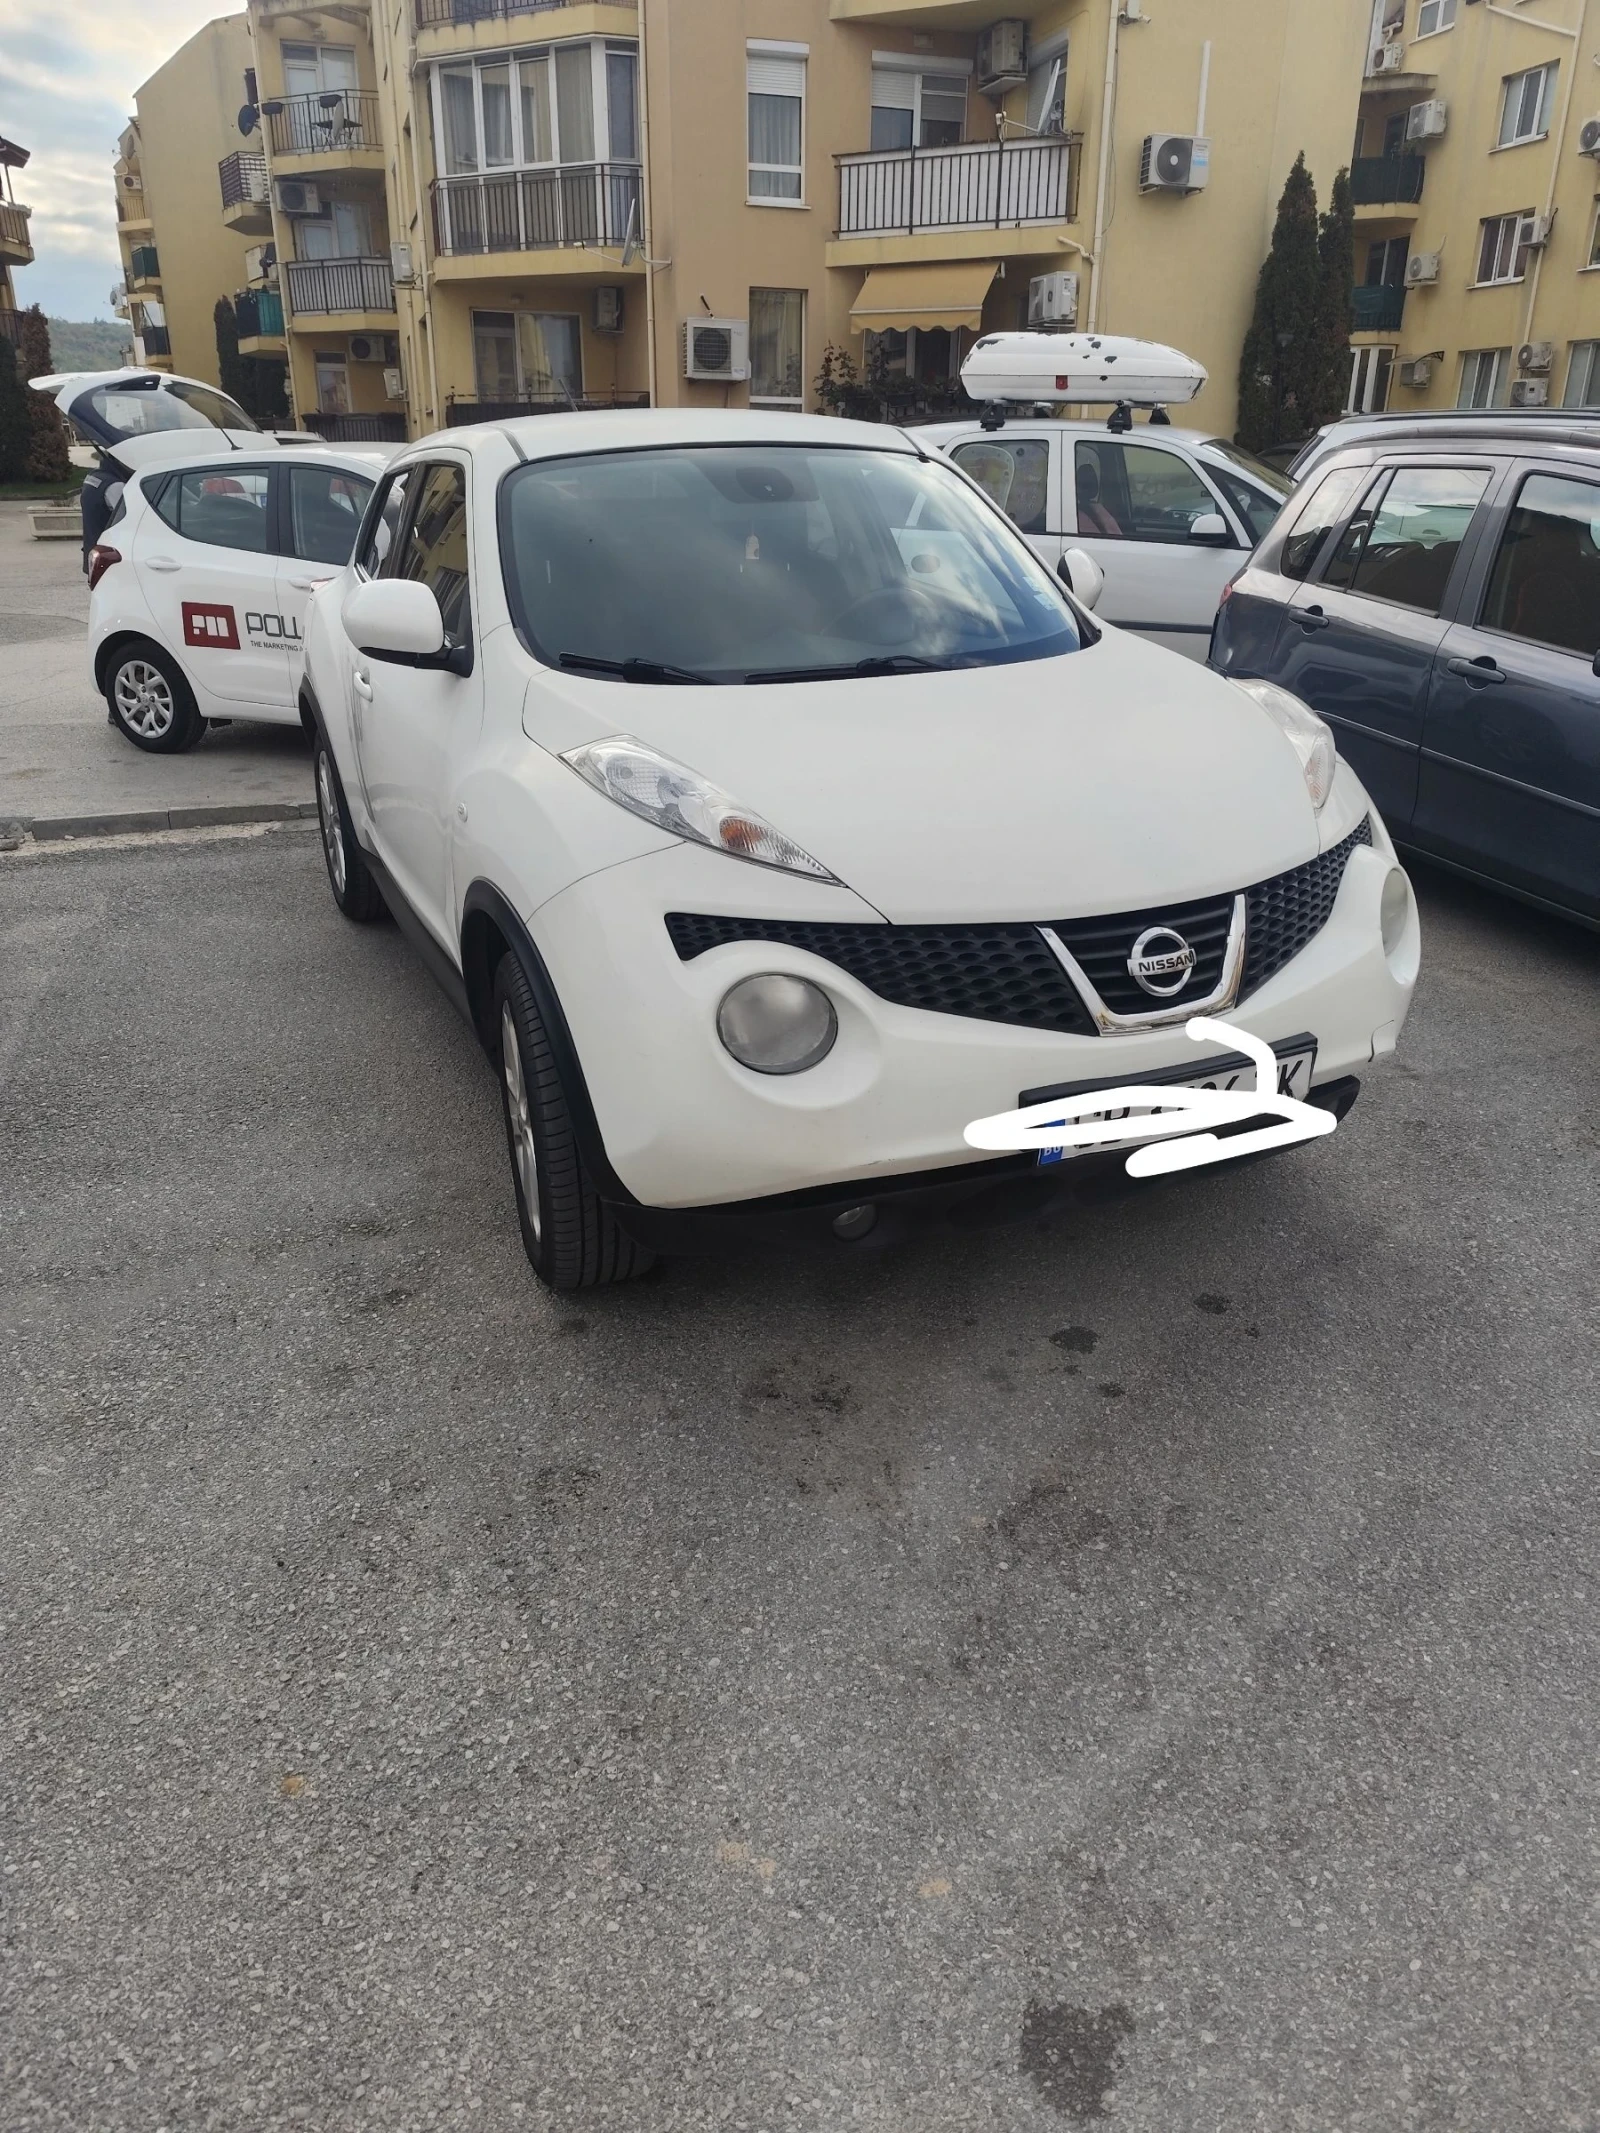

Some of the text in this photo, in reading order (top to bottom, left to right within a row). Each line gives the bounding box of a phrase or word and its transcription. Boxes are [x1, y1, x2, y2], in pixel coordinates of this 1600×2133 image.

[250, 640, 262, 648] THE
[263, 641, 298, 652] MARKETING
[1138, 951, 1194, 973] NISSAN
